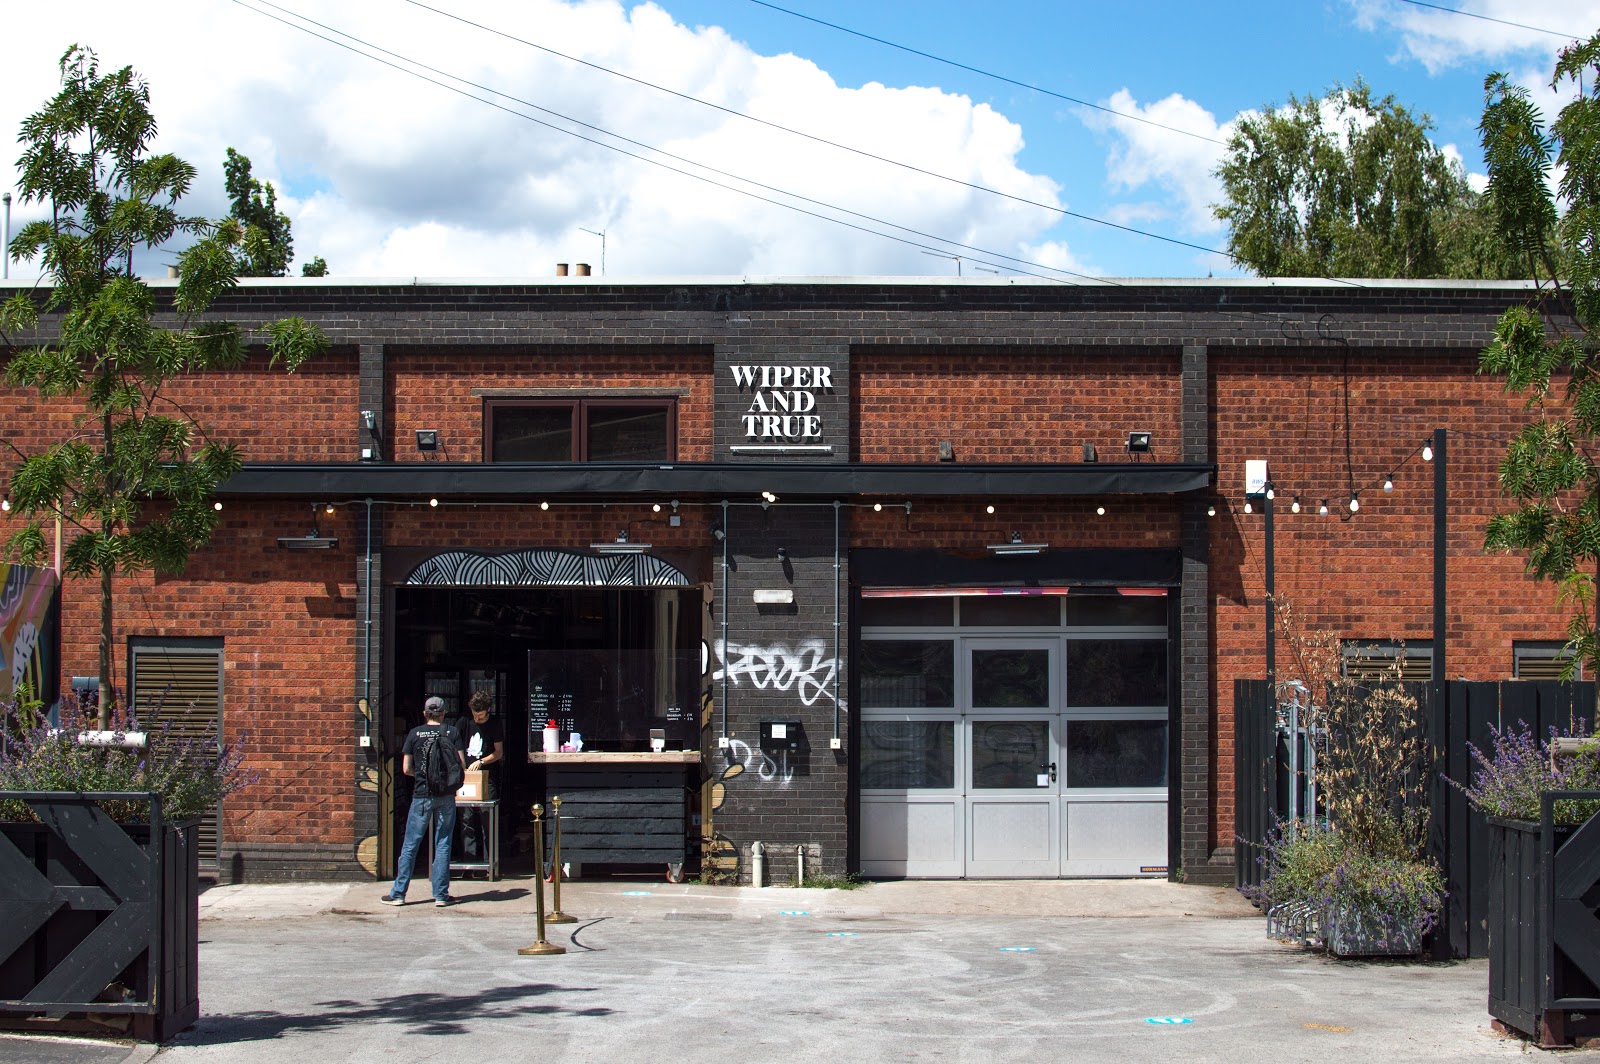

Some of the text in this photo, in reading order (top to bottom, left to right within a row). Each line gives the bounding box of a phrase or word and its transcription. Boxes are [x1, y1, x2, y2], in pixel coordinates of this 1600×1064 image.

[729, 365, 833, 388] WIPER
[748, 390, 815, 412] AND
[741, 415, 821, 437] TRUE
